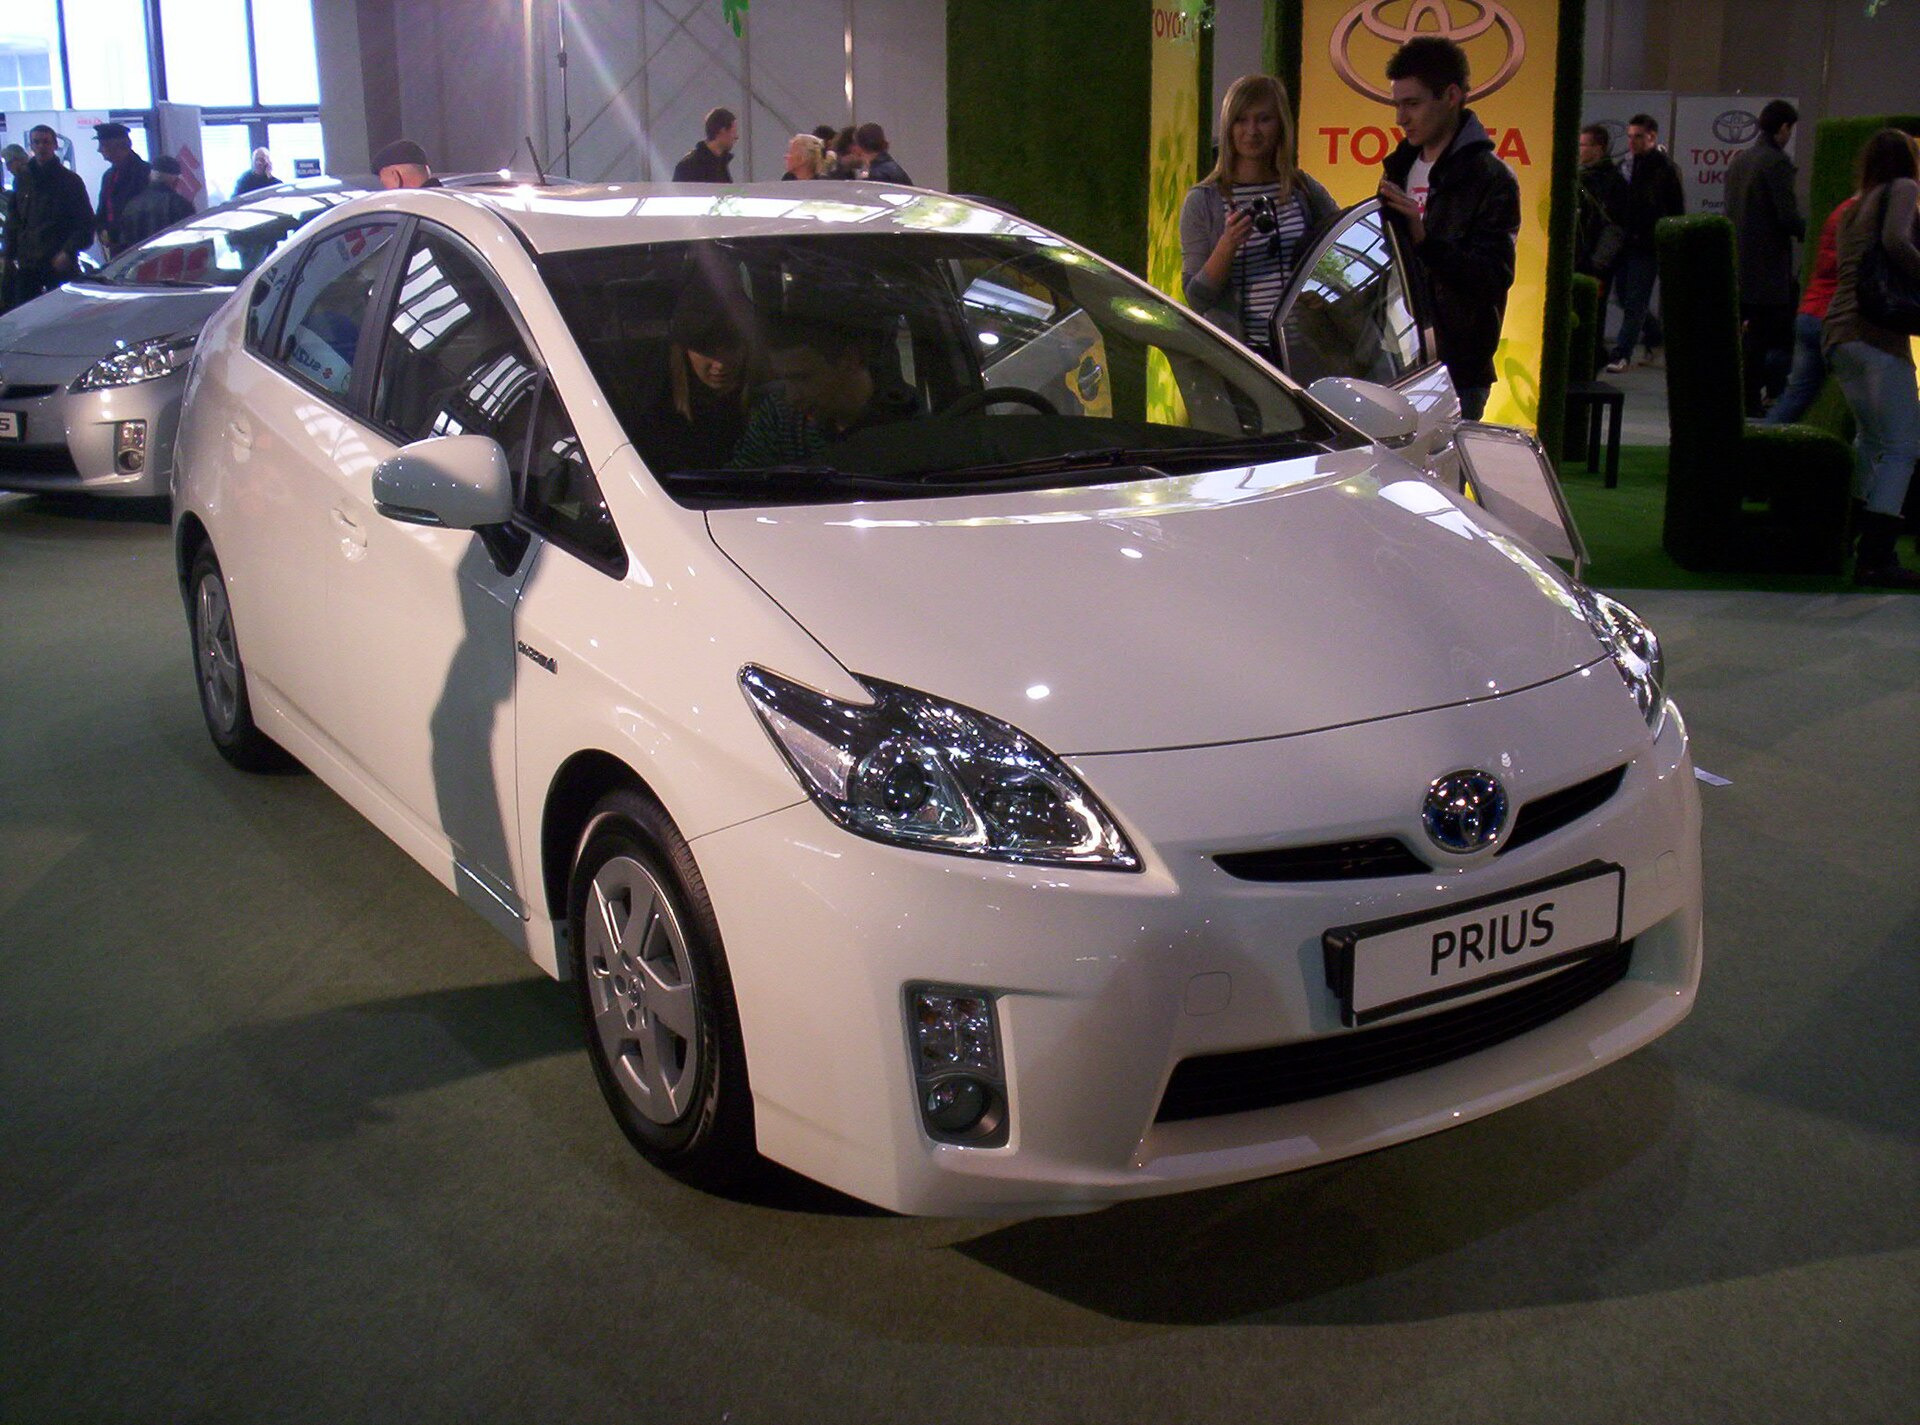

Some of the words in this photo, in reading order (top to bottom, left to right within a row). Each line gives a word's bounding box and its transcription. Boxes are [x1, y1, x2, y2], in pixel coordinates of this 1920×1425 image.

[1319, 126, 1532, 166] TOA
[1690, 149, 1745, 166] TOY
[1430, 902, 1555, 976] PRIUS
